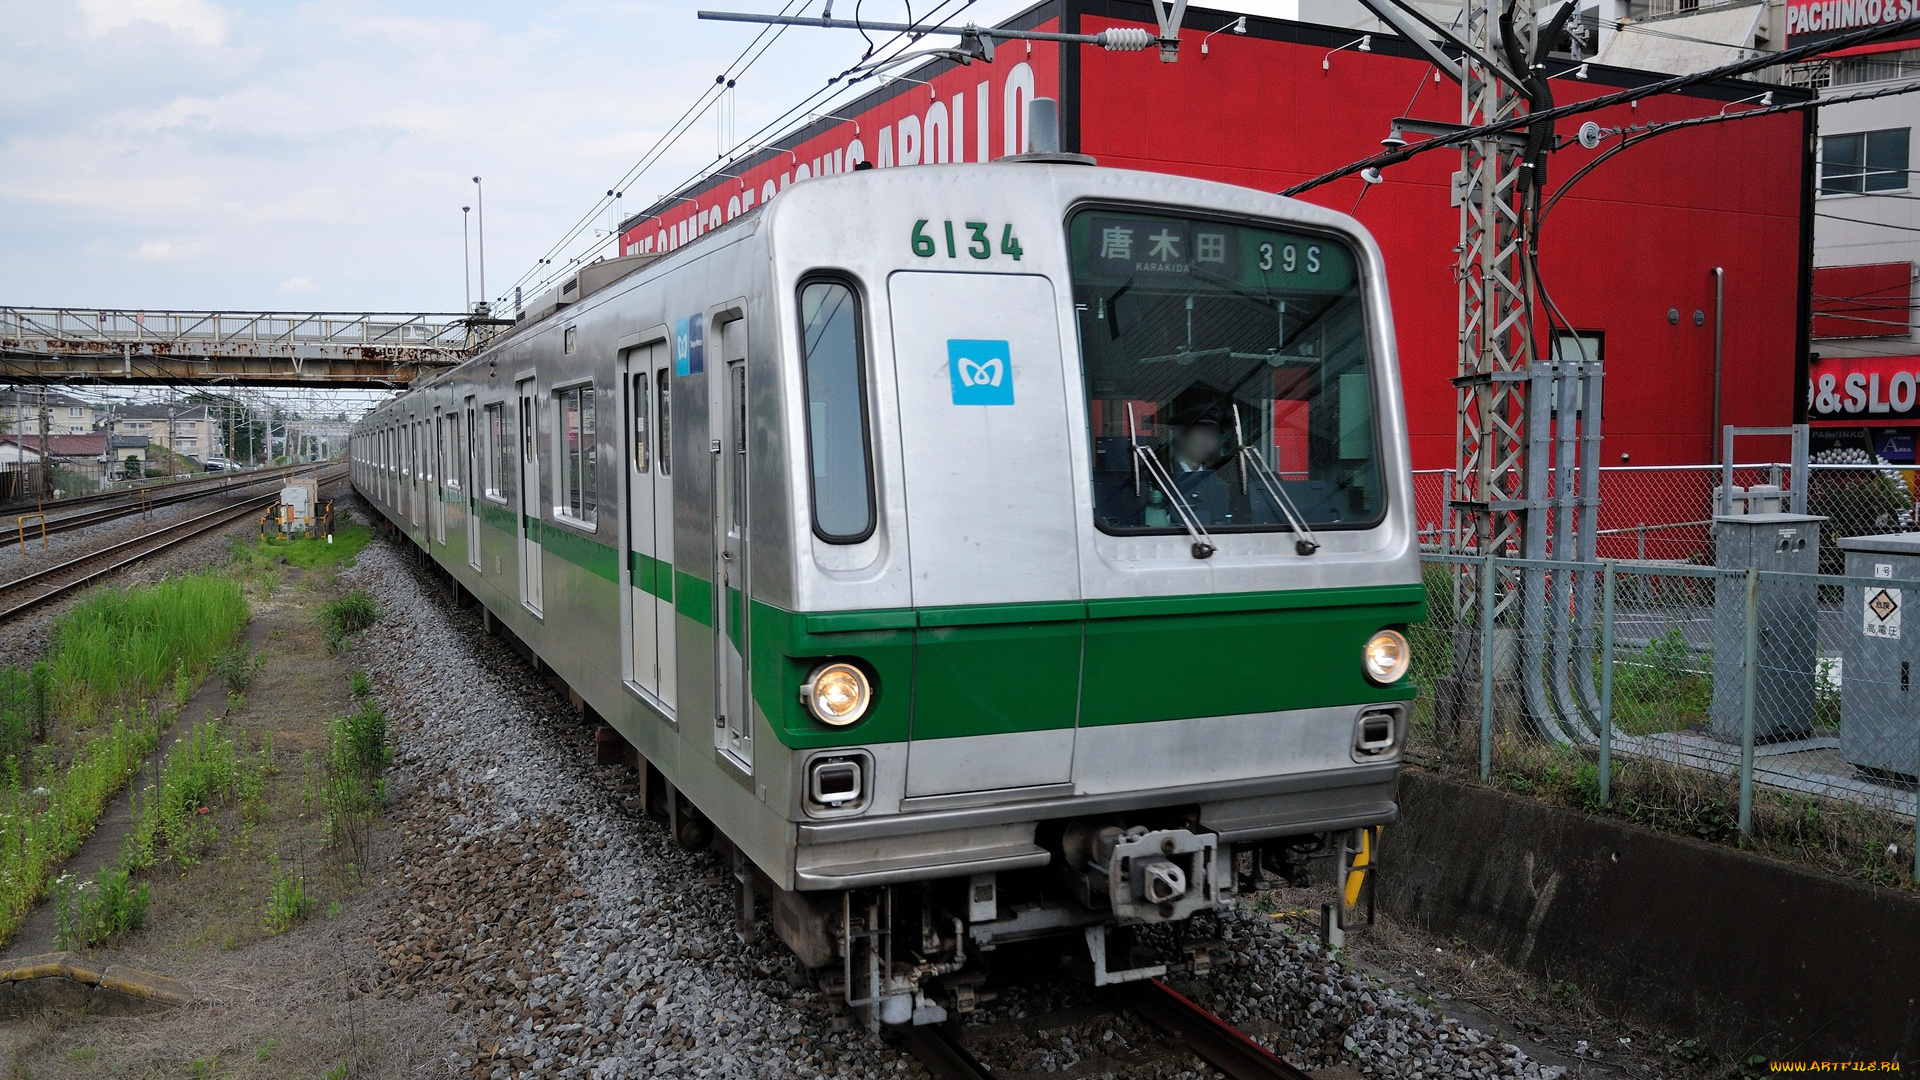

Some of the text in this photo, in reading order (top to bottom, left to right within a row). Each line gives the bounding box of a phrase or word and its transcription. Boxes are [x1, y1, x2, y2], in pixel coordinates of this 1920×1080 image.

[911, 219, 1024, 262] 6134
[1100, 226, 1226, 264] 唐木田
[1258, 242, 1322, 274] 39S
[1135, 262, 1190, 273] KARAKIDA
[1808, 371, 1920, 414] &SLO
[1866, 623, 1898, 637] 高電圧
